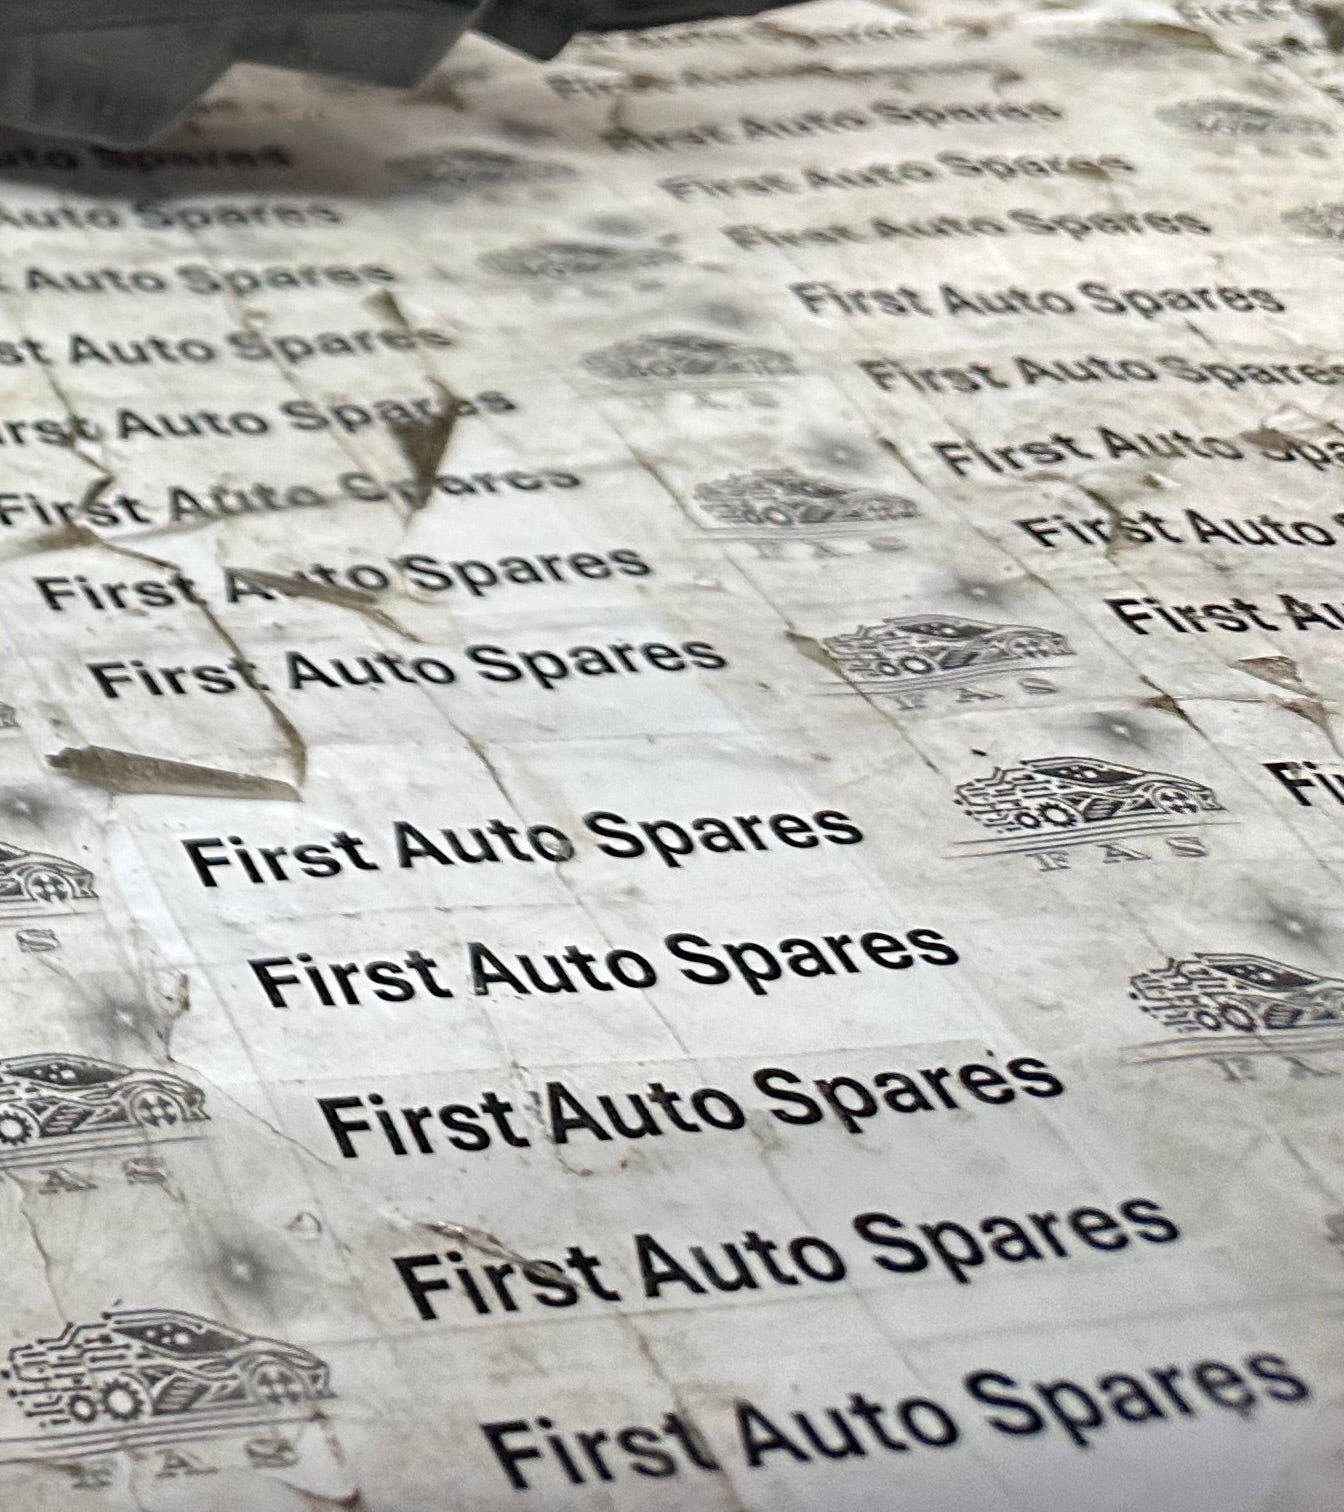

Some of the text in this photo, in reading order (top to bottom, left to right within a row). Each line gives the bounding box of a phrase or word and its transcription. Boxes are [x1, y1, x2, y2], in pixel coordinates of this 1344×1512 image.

[739, 109, 871, 142] Auto
[869, 99, 1063, 129] Spares
[90, 142, 291, 176] Spares
[656, 173, 796, 203] First
[801, 161, 938, 190] Auto
[126, 194, 345, 234] Spares
[720, 208, 1214, 252] First Auto Spares
[25, 266, 166, 294] Auto
[176, 263, 400, 302] Spares
[788, 281, 1288, 322] First Auto Spares
[69, 333, 218, 366] Auto
[225, 322, 455, 367] Spares
[859, 356, 1004, 395] First
[1018, 355, 1160, 386] Auto
[116, 408, 271, 440] Auto
[931, 436, 1090, 483] First
[1096, 425, 1246, 461] Auto
[1014, 502, 1337, 550] First Auto
[33, 566, 203, 616] First
[395, 549, 654, 598] Spares
[1103, 597, 1281, 636] First
[86, 641, 729, 702] First Auto Spares
[181, 810, 865, 888] First Auto Spares
[247, 926, 962, 1009] First Auto Spares
[316, 1049, 1066, 1159] First Auto Spares
[391, 1198, 1181, 1321] First Auto Spares
[479, 1353, 1313, 1492] First Auto Spares
